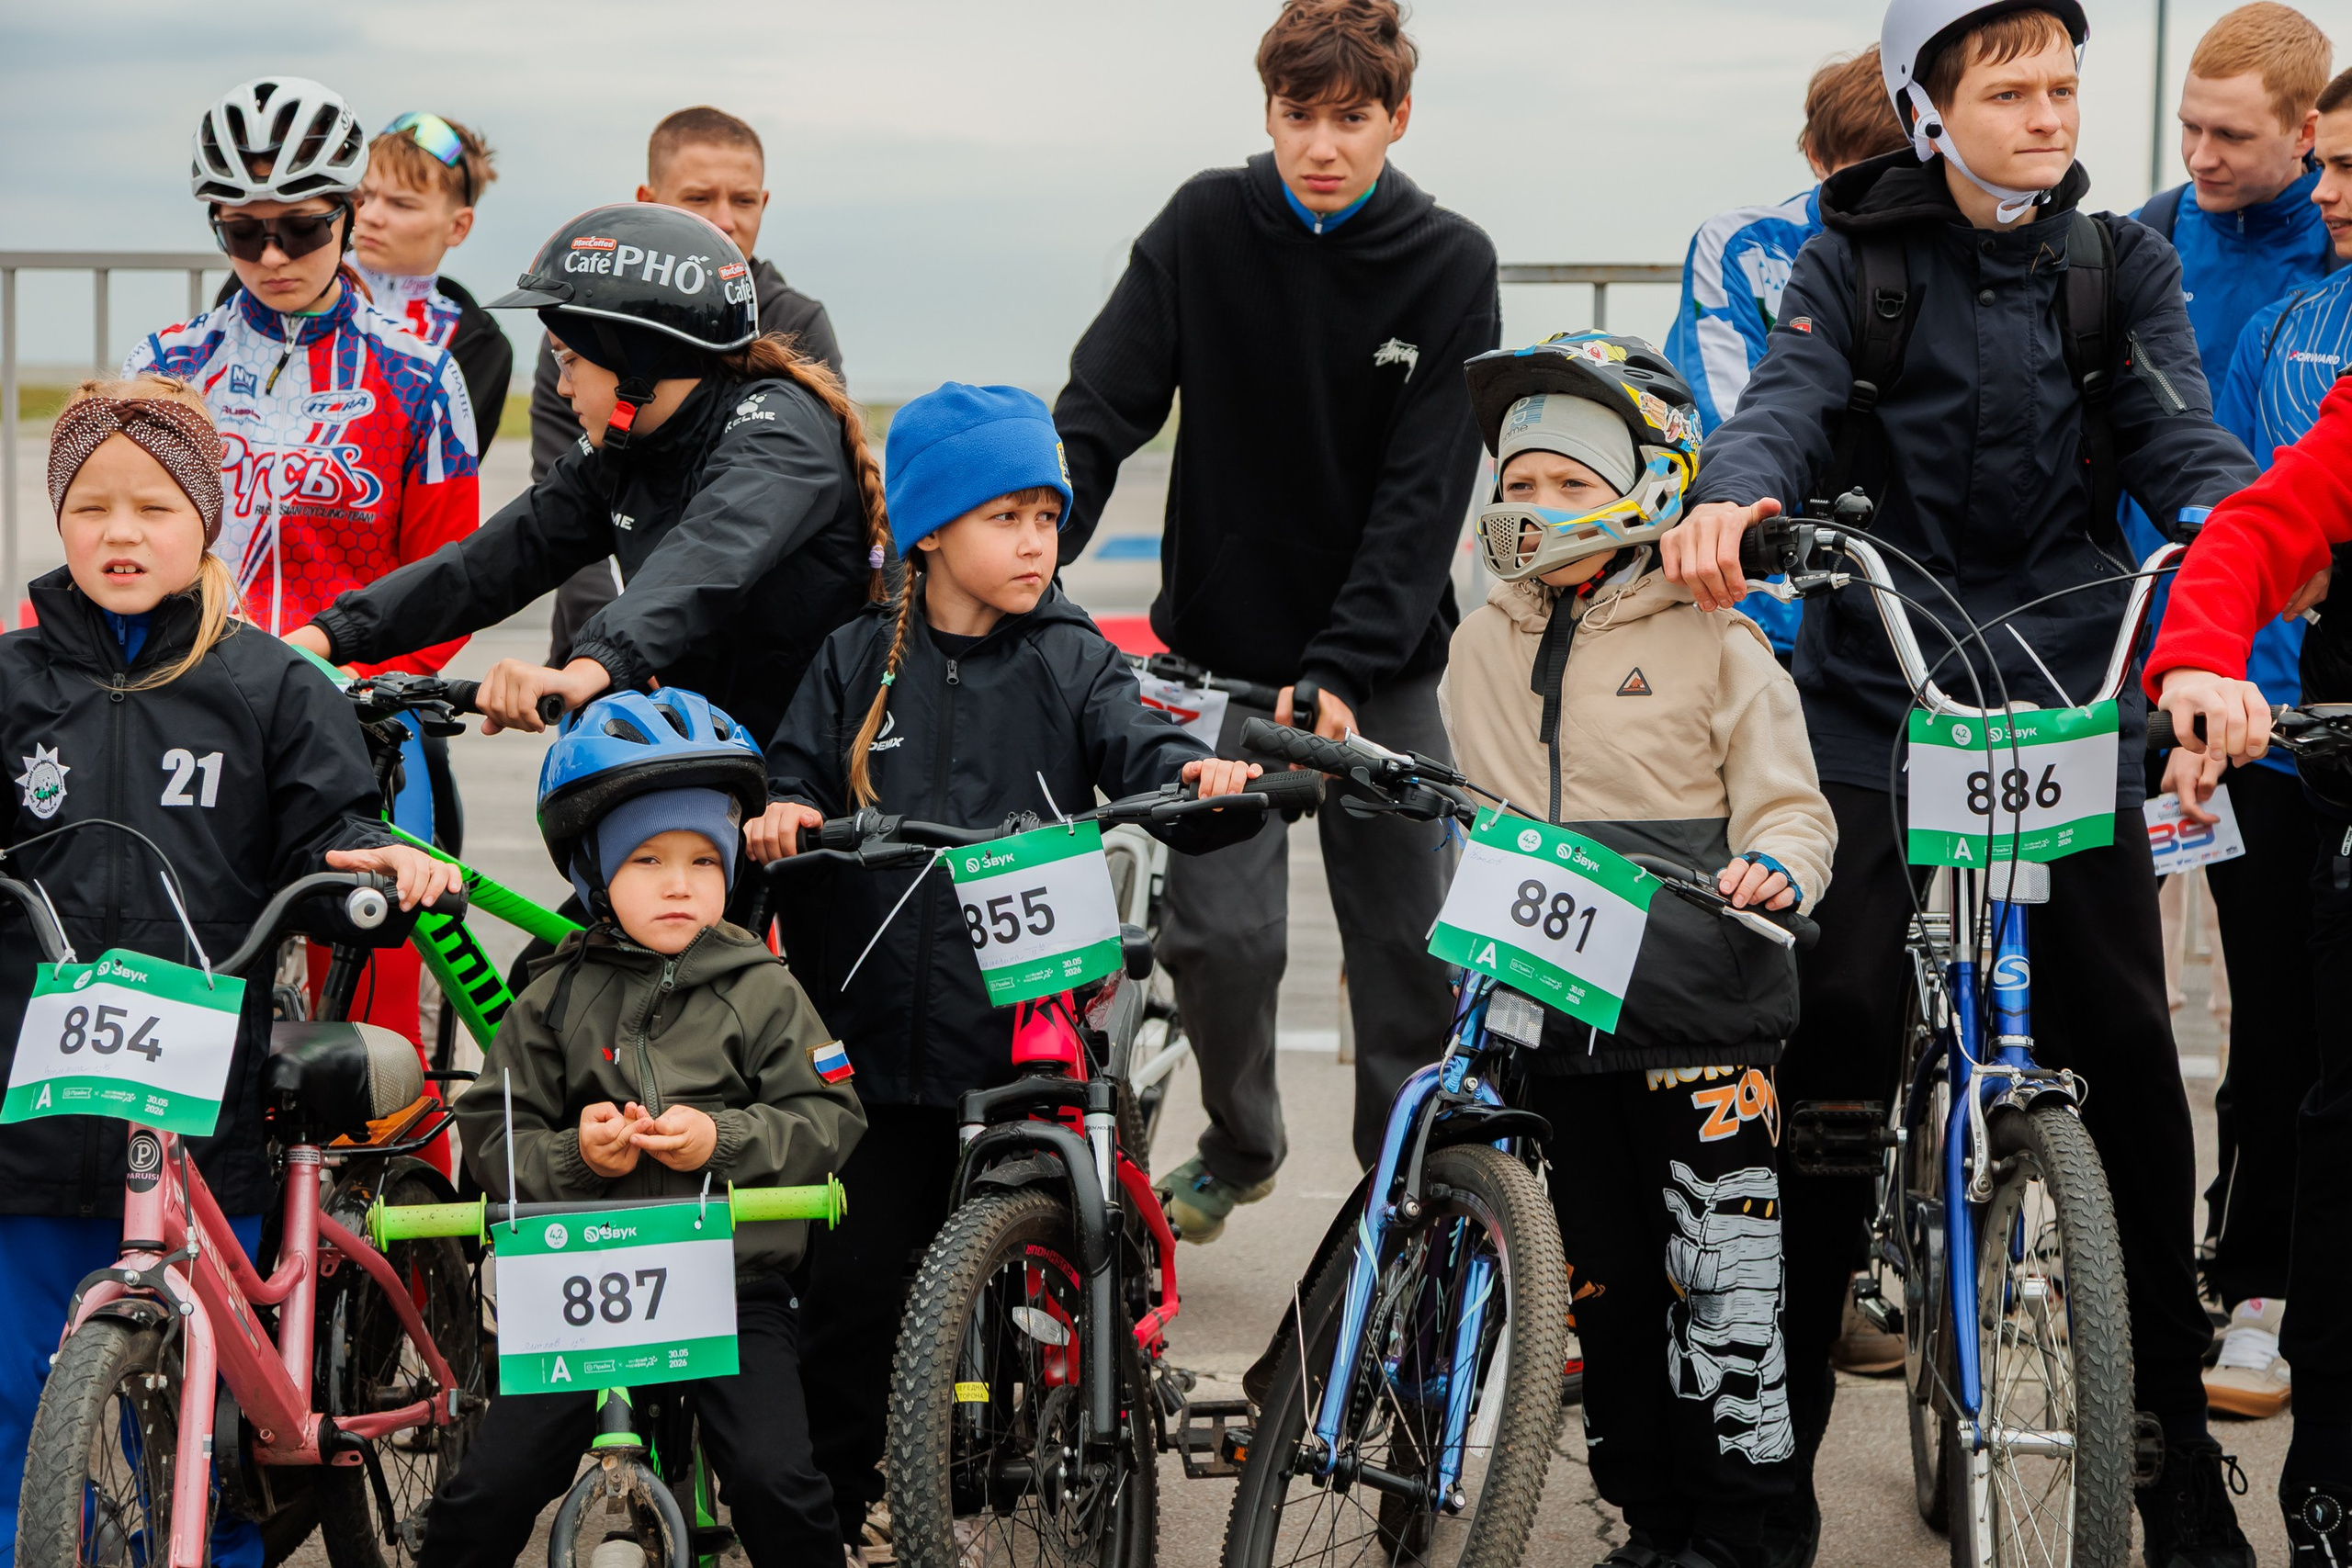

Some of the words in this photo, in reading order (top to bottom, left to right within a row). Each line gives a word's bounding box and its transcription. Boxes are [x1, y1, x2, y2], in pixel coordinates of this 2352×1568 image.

[565, 251, 613, 274] Café
[2289, 351, 2340, 365] FORWARD
[724, 411, 775, 434] KELME
[302, 506, 345, 519] CYCLING
[346, 510, 375, 523] TEAM
[2005, 727, 2038, 739] Звук
[161, 749, 223, 807] 21
[1967, 763, 2062, 815] 886
[982, 853, 1015, 869] Звук
[1572, 852, 1600, 873] Звук
[963, 886, 1055, 950] 855
[1511, 879, 1598, 954] 881
[1062, 956, 1082, 968] 30.05
[112, 963, 148, 984] Звук
[1064, 965, 1082, 977] 2026
[59, 1005, 163, 1063] 854
[146, 1094, 168, 1107] 30.05
[144, 1103, 164, 1116] 2026
[127, 1172, 160, 1180] PARUISI
[602, 1226, 637, 1240] Звук
[563, 1268, 667, 1326] 887
[668, 1348, 689, 1359] 30.05
[669, 1359, 687, 1369] 2026
